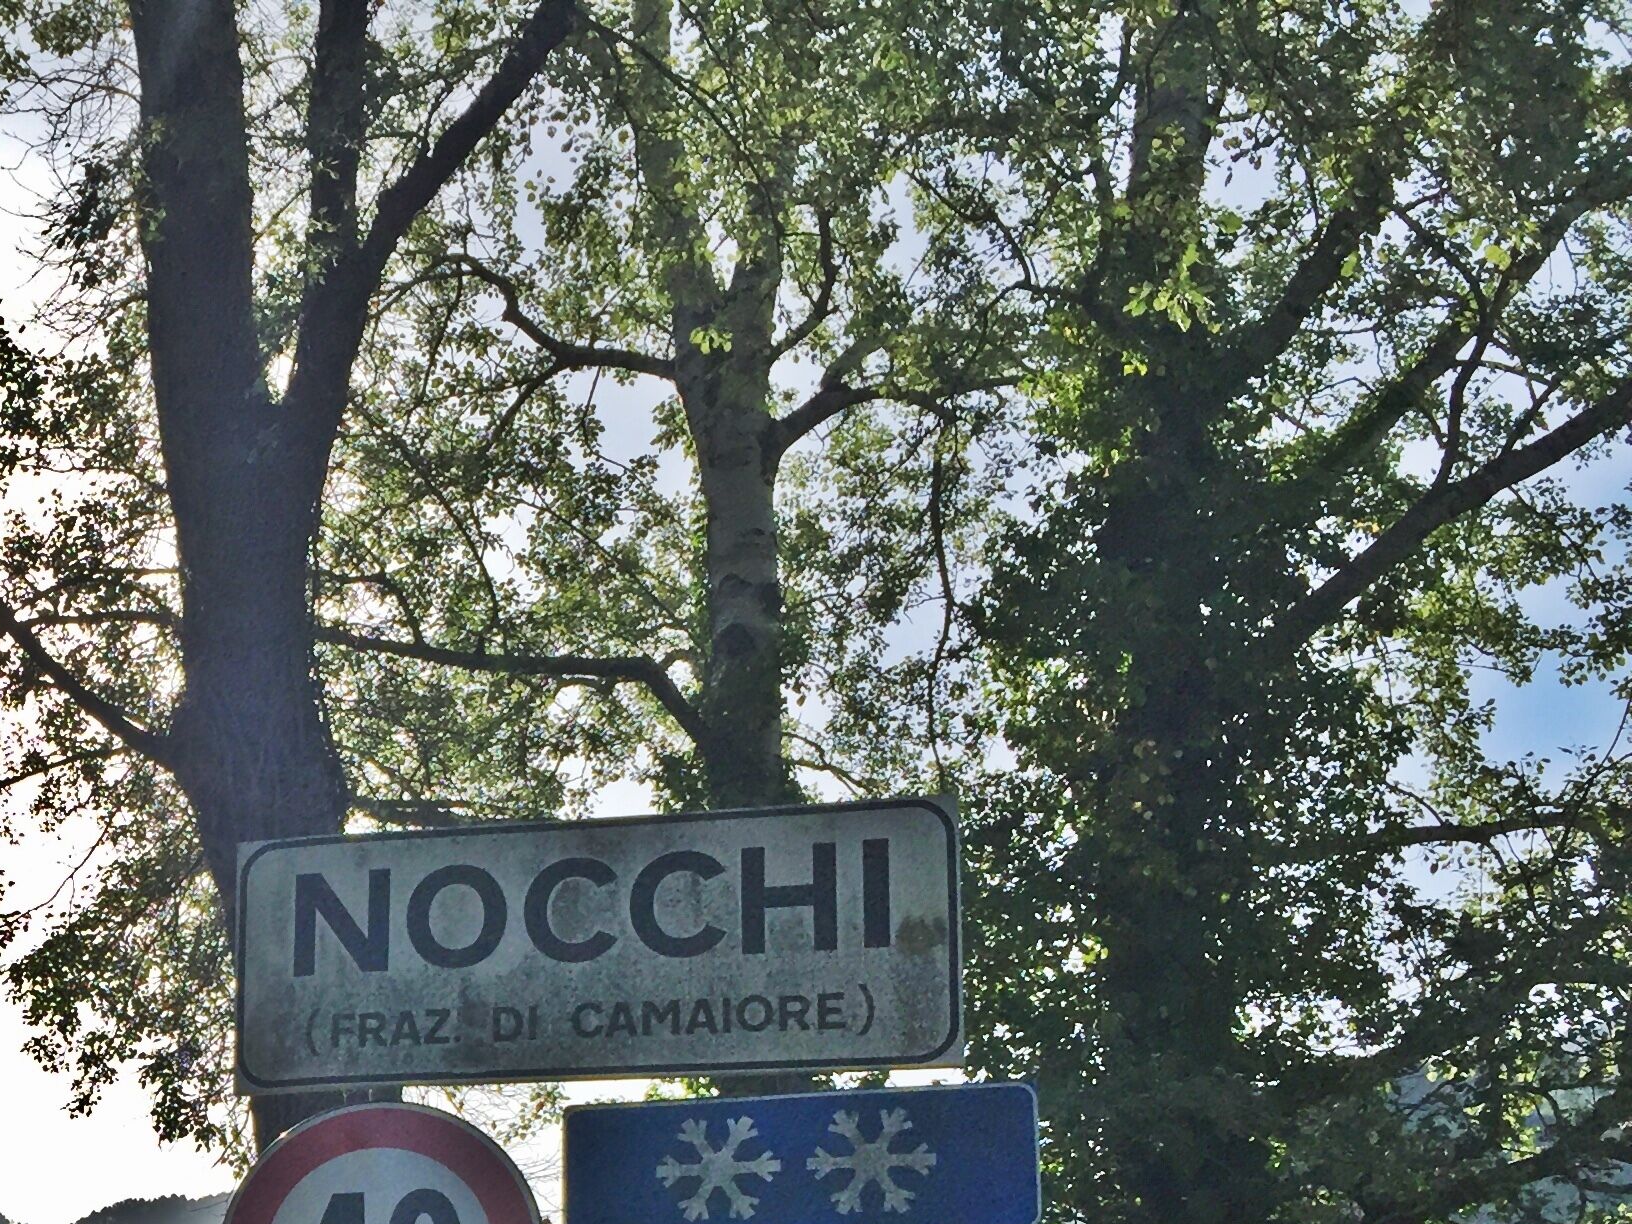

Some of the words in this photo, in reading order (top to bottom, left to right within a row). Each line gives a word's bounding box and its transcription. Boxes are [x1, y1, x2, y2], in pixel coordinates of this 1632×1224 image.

[292, 838, 892, 978] NOCCHI
[305, 1006, 462, 1057] (FRAZ.
[491, 1004, 539, 1043] DI
[570, 983, 876, 1039] CAMAIORE)
